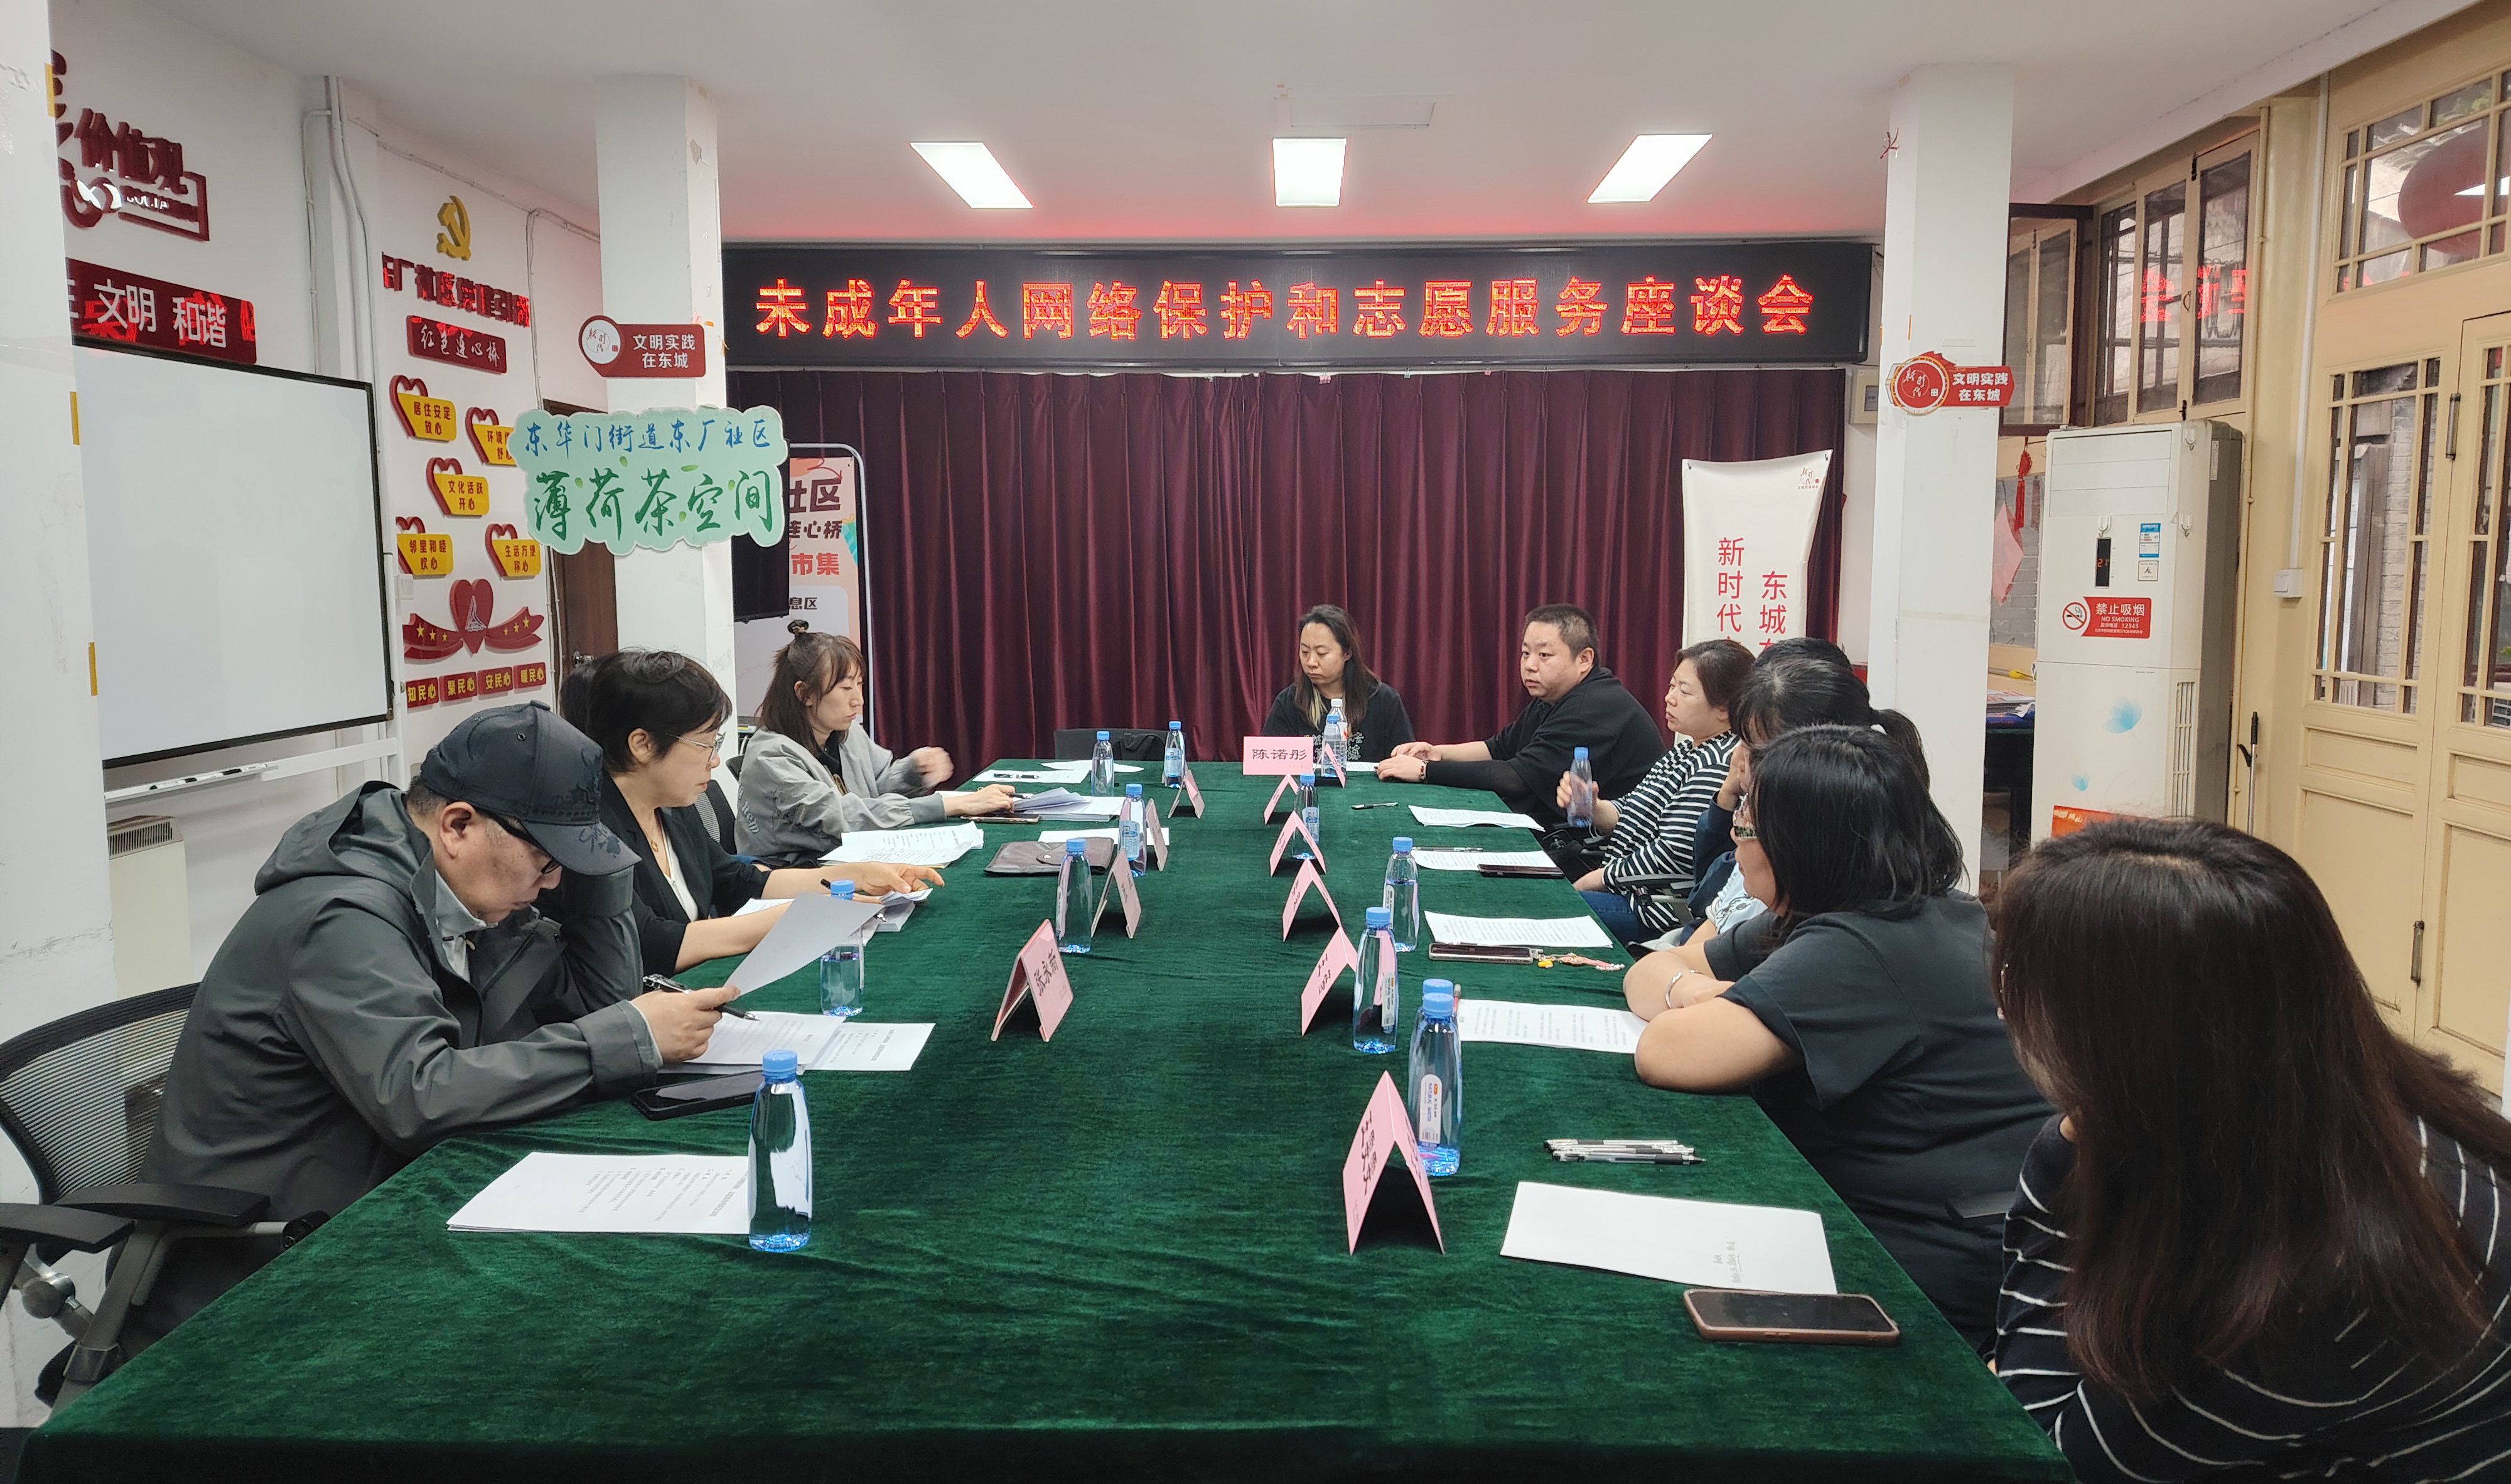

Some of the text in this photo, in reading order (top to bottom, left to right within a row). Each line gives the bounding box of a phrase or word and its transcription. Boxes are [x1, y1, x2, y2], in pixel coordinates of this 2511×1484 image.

[74, 107, 189, 195] 价值观
[94, 278, 158, 333] 文明
[171, 296, 227, 348] 和谐
[755, 274, 1815, 340] 未成年人网络保护和志愿服务座谈会
[421, 324, 500, 367] 红色连心桥
[633, 333, 696, 351] 文明实践
[642, 352, 689, 369] 在东城
[1952, 373, 2009, 386] 文明实践
[1959, 389, 2001, 402] 在东城
[414, 401, 451, 421] 居住安定
[424, 421, 443, 436] 放心
[525, 419, 771, 459] 东华门街道东厂社区
[448, 480, 483, 495] 文化活跃
[458, 497, 475, 512] 开心
[534, 468, 773, 542] 薄荷茶空间
[409, 539, 447, 554] 邻里和睦
[505, 544, 536, 557] 生活方便
[420, 557, 438, 571] 欢心
[791, 552, 840, 576] 市集
[1716, 537, 1745, 645] 新时代
[2095, 602, 2146, 616] 禁止吸烟
[485, 670, 512, 690] 安民心
[520, 667, 545, 684] 暖民心
[407, 684, 436, 703] 知民心
[447, 676, 475, 696] 聚民心
[1251, 748, 1308, 761] 陈诺彤
[1033, 948, 1059, 997] 张永新
